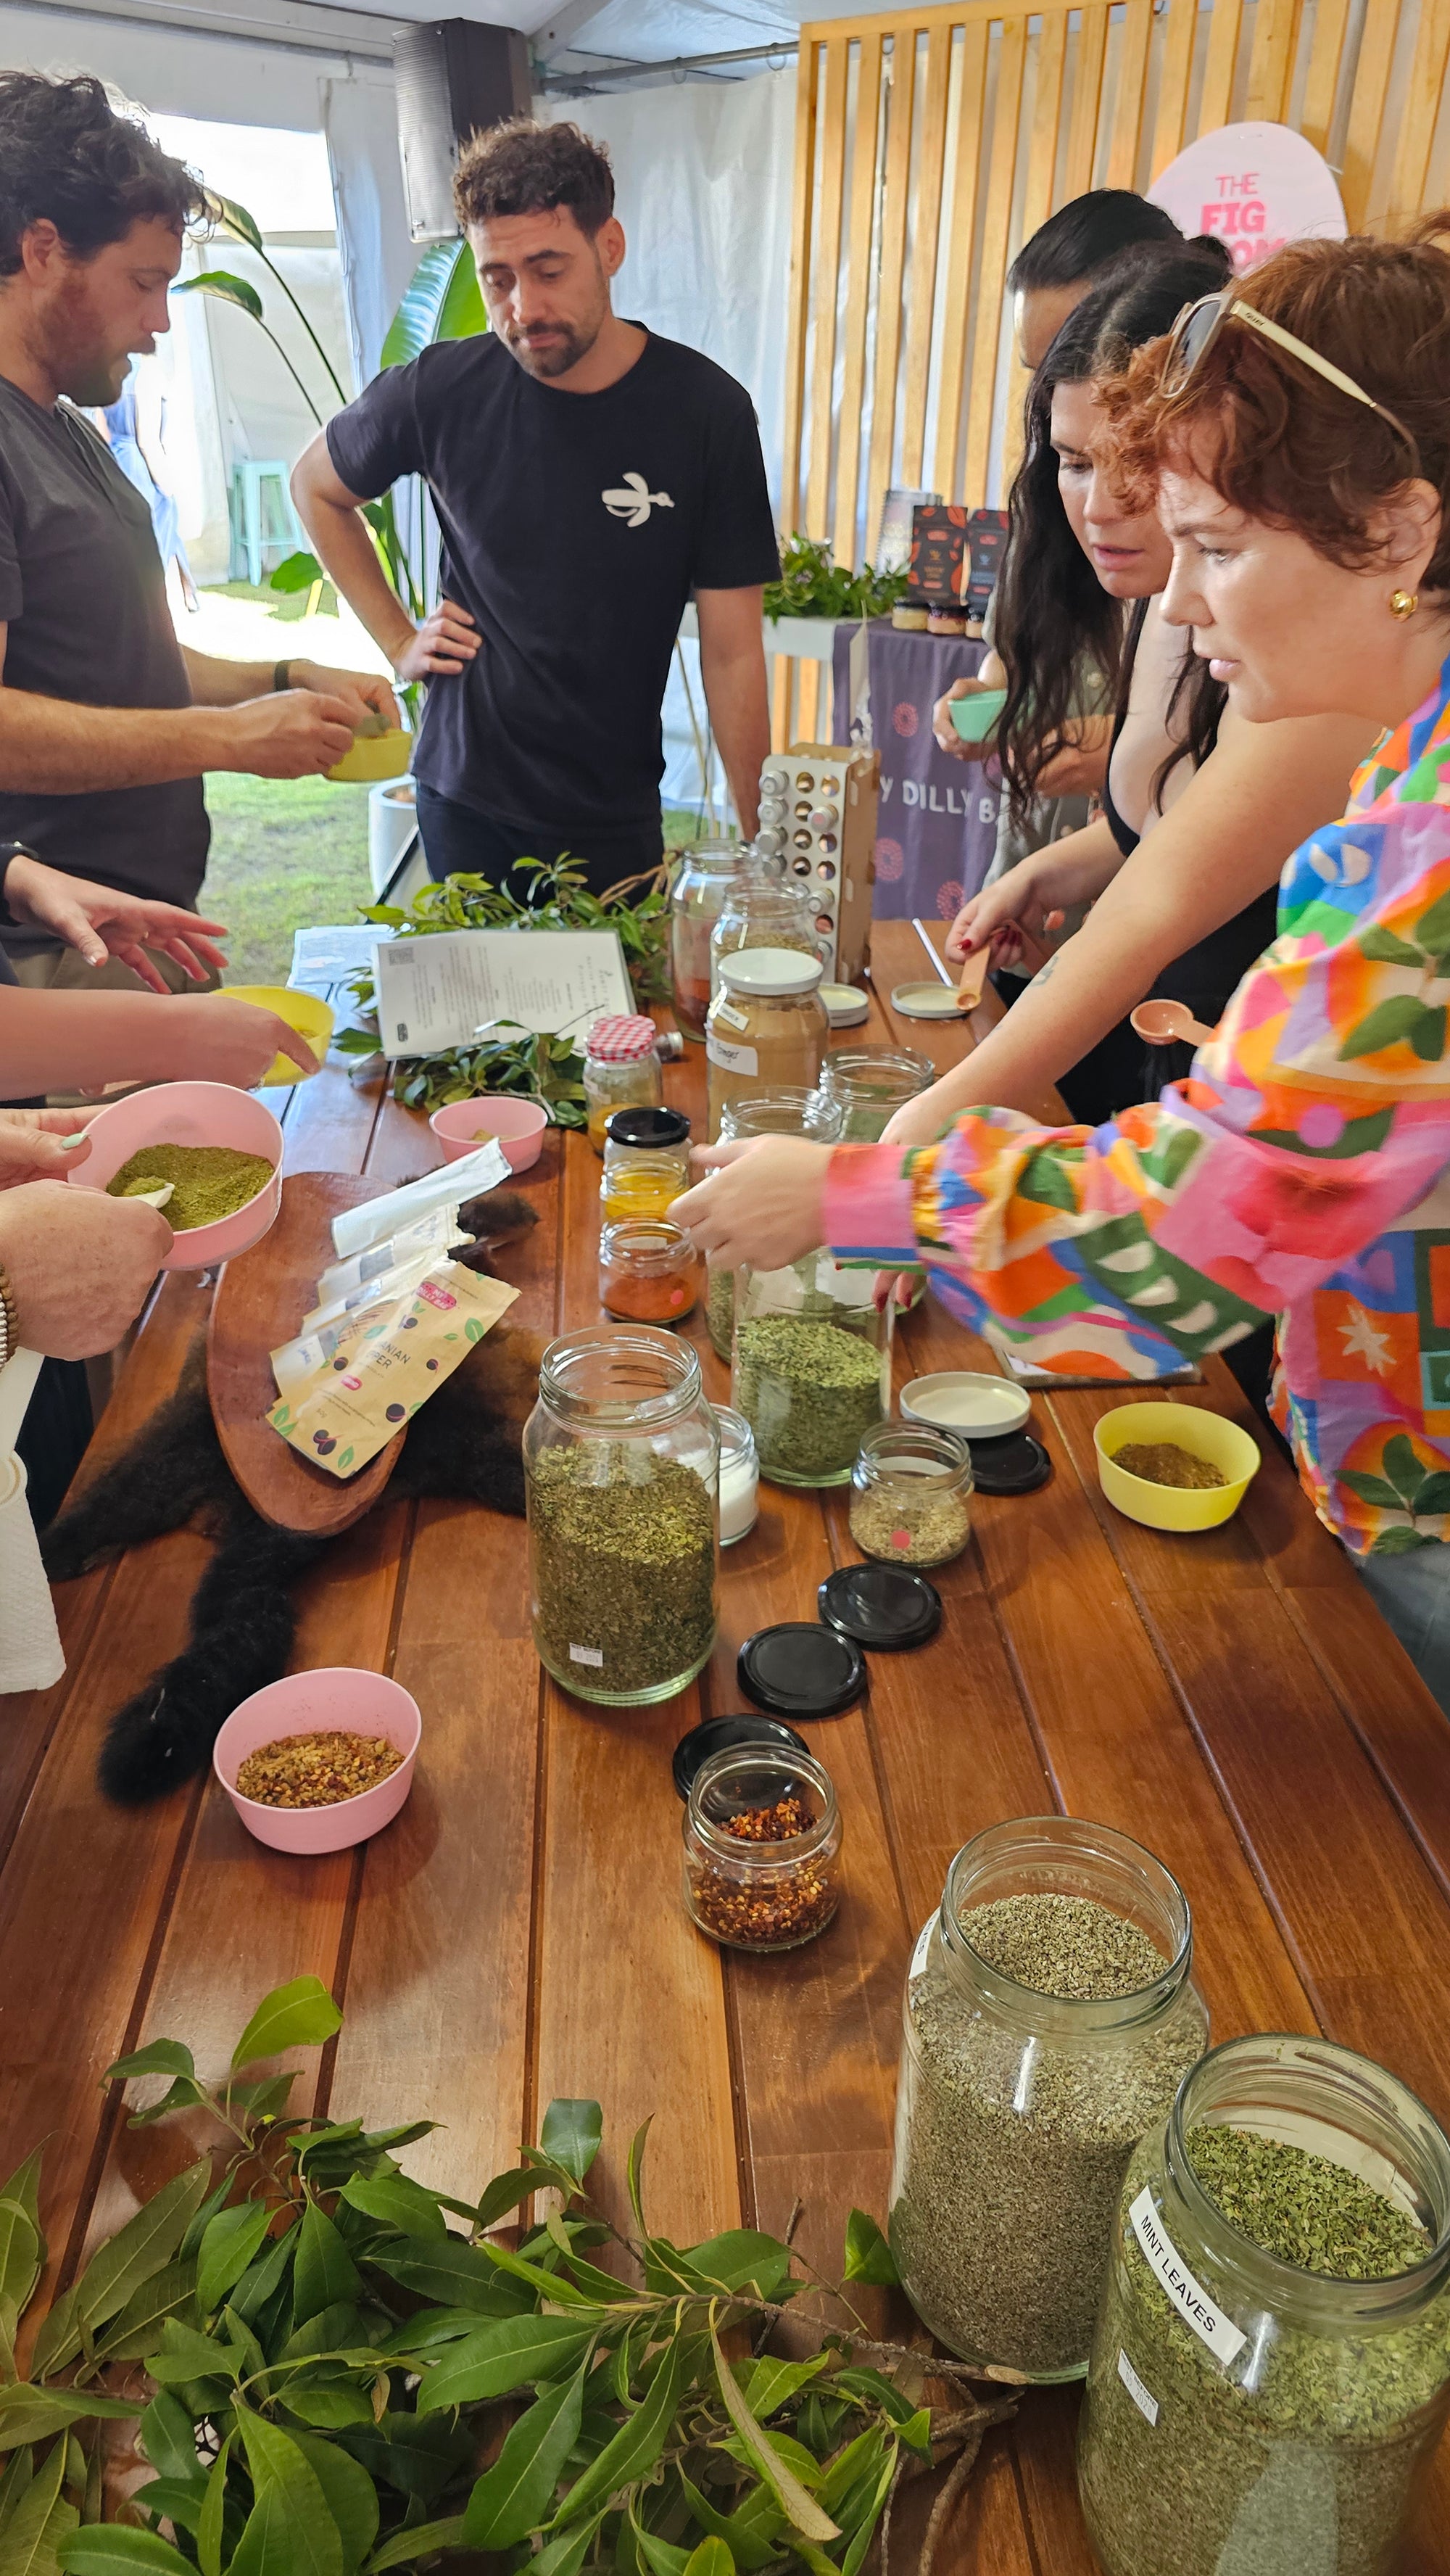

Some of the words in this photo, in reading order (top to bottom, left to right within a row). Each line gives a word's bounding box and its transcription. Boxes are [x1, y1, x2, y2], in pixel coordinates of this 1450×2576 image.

[1215, 173, 1260, 197] THE
[1200, 200, 1267, 236] FIG
[879, 774, 894, 803] Y
[902, 779, 972, 817] DILLY
[365, 1350, 393, 1370] PPER
[380, 1340, 412, 1364] ANIAN
[1141, 2215, 1164, 2257] MINT
[1161, 2258, 1216, 2332] LEAVES
